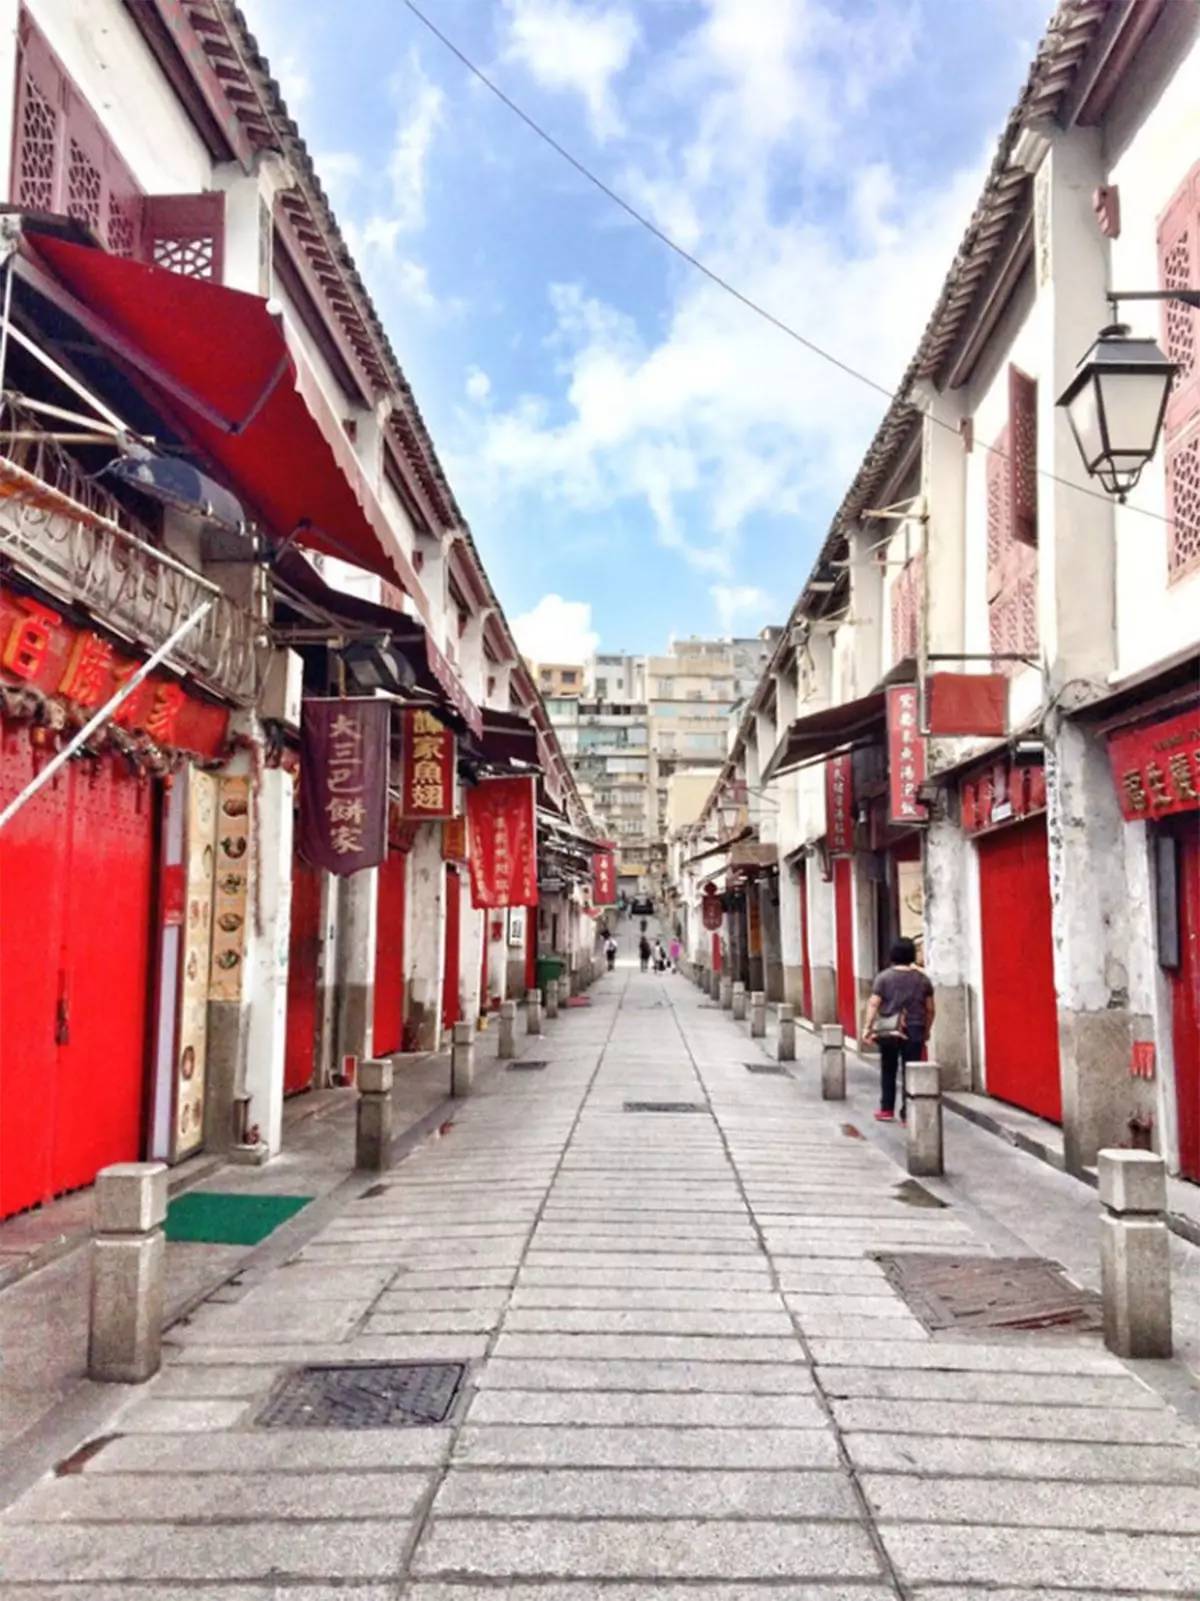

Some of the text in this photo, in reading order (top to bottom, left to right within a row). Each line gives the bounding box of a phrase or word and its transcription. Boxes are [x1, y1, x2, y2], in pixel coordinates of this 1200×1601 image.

[325, 714, 366, 854] 大三巴餅家
